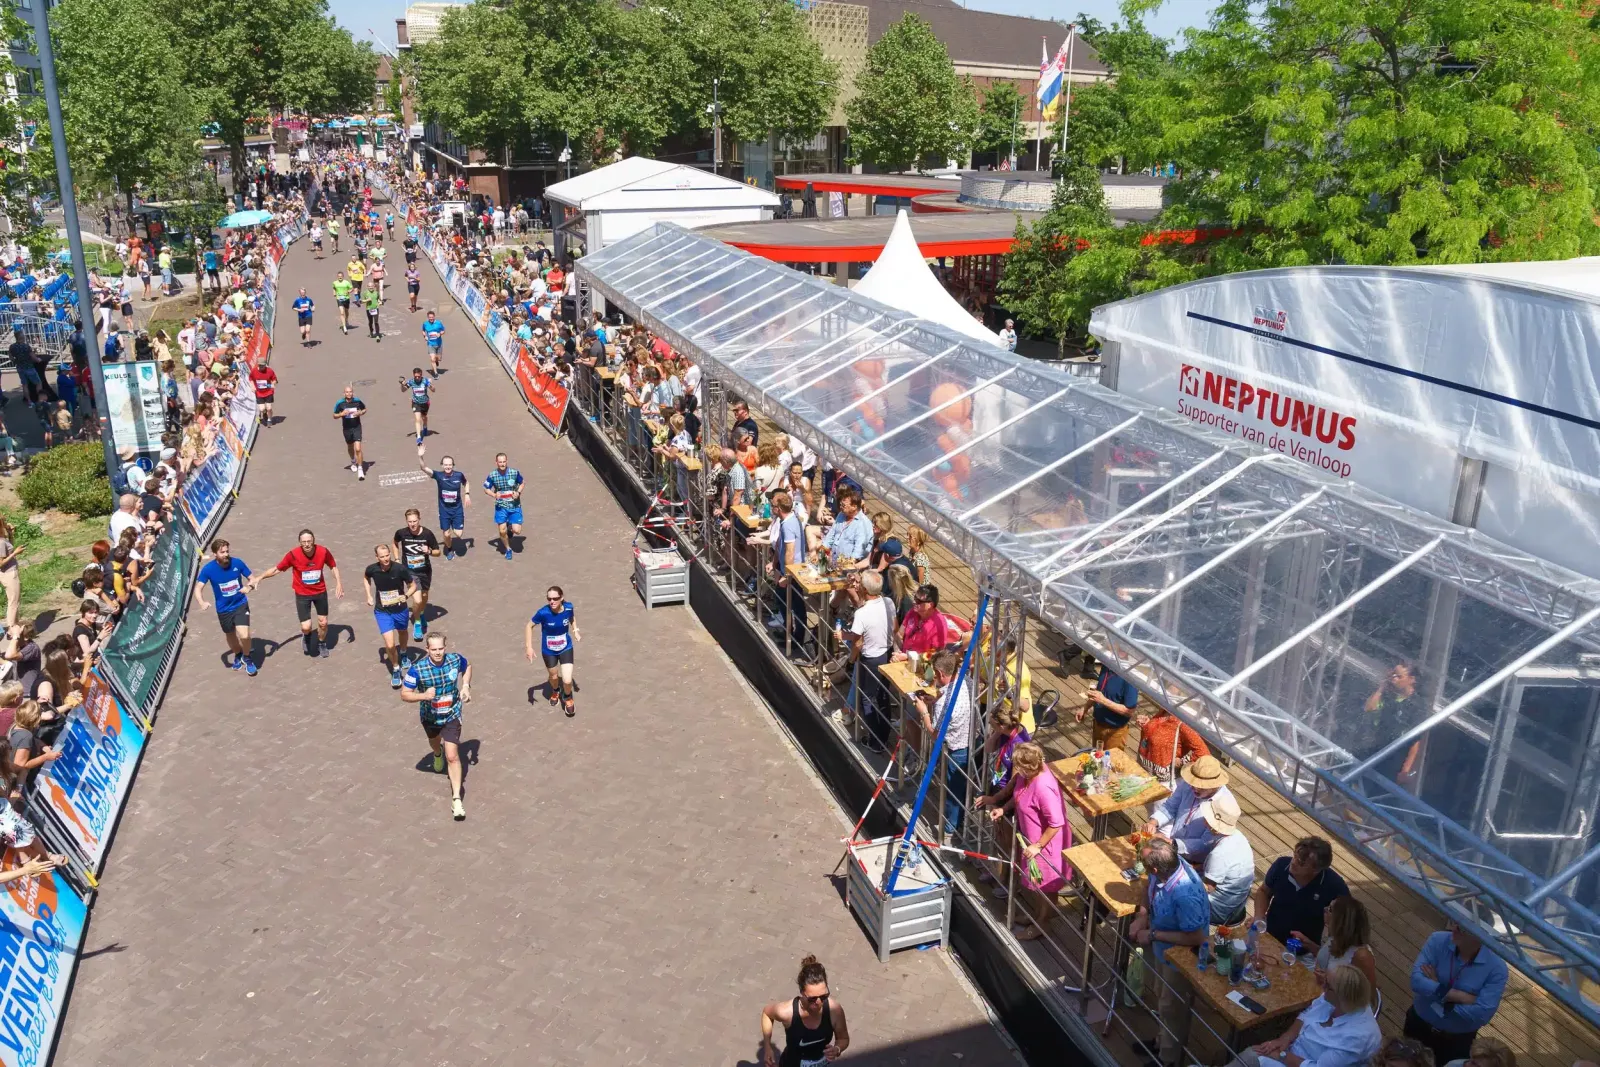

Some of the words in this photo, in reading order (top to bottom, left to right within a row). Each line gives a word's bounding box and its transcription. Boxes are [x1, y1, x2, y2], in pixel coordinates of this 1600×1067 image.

[1254, 316, 1285, 331] NEPTUNUS
[1177, 398, 1239, 434] Supporter
[1242, 425, 1265, 445] van
[1269, 432, 1286, 452] de
[1290, 438, 1352, 478] Venloop
[1203, 371, 1357, 451] NEPTUNUS
[74, 725, 122, 820] VENLOOP
[0, 902, 60, 1055] VENLOOP
